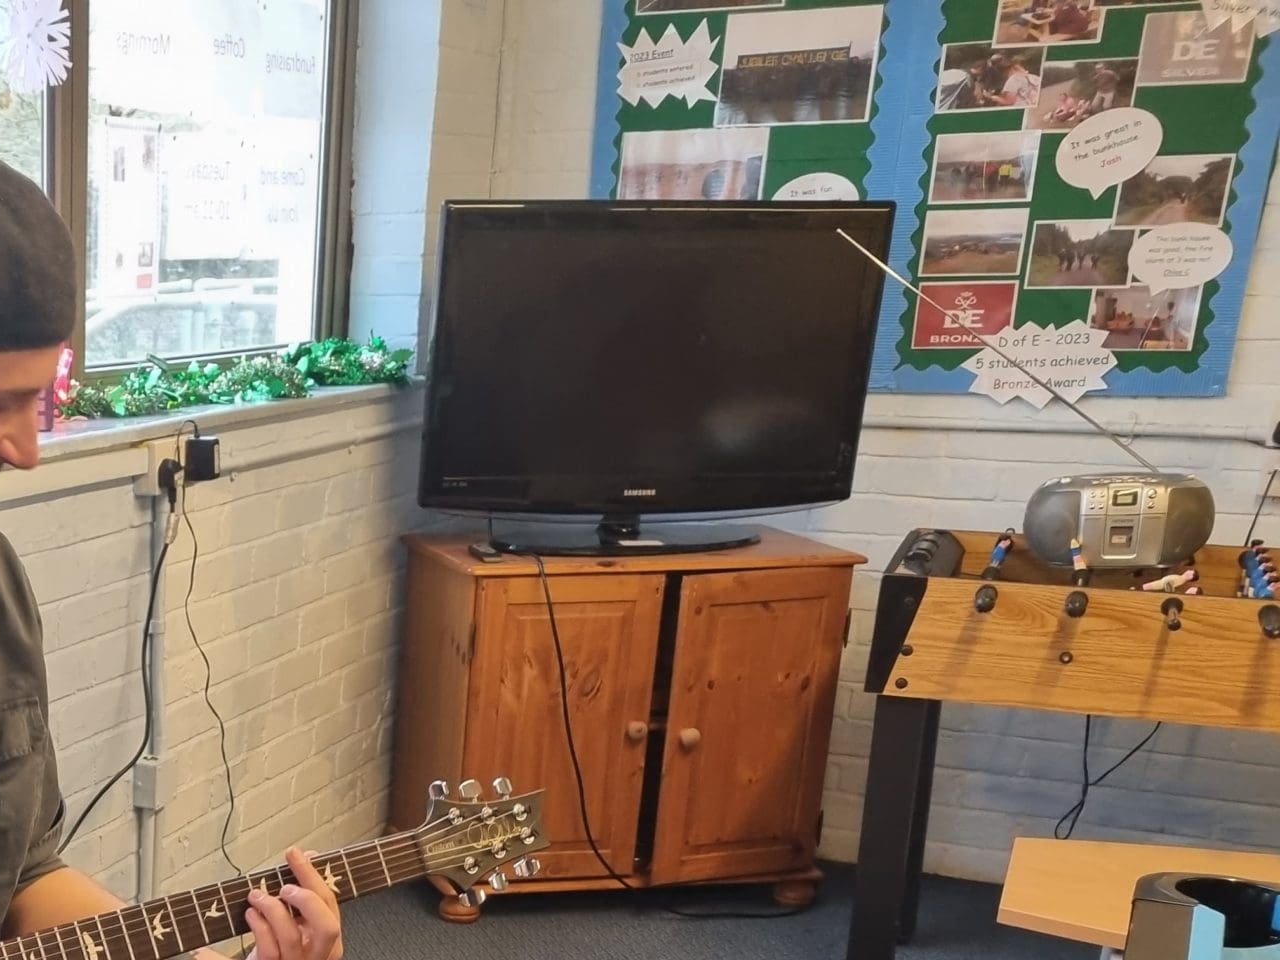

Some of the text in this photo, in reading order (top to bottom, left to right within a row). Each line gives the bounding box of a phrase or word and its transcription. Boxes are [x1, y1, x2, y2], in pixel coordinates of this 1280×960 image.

[1104, 124, 1129, 140] great
[930, 334, 982, 343] BRONZ
[998, 336, 1008, 347] D
[1013, 335, 1027, 347] of
[1032, 334, 1041, 346] E
[1056, 332, 1091, 345] 2023
[976, 354, 1110, 369] 5 students achieved
[993, 376, 1087, 389] Bronze Award
